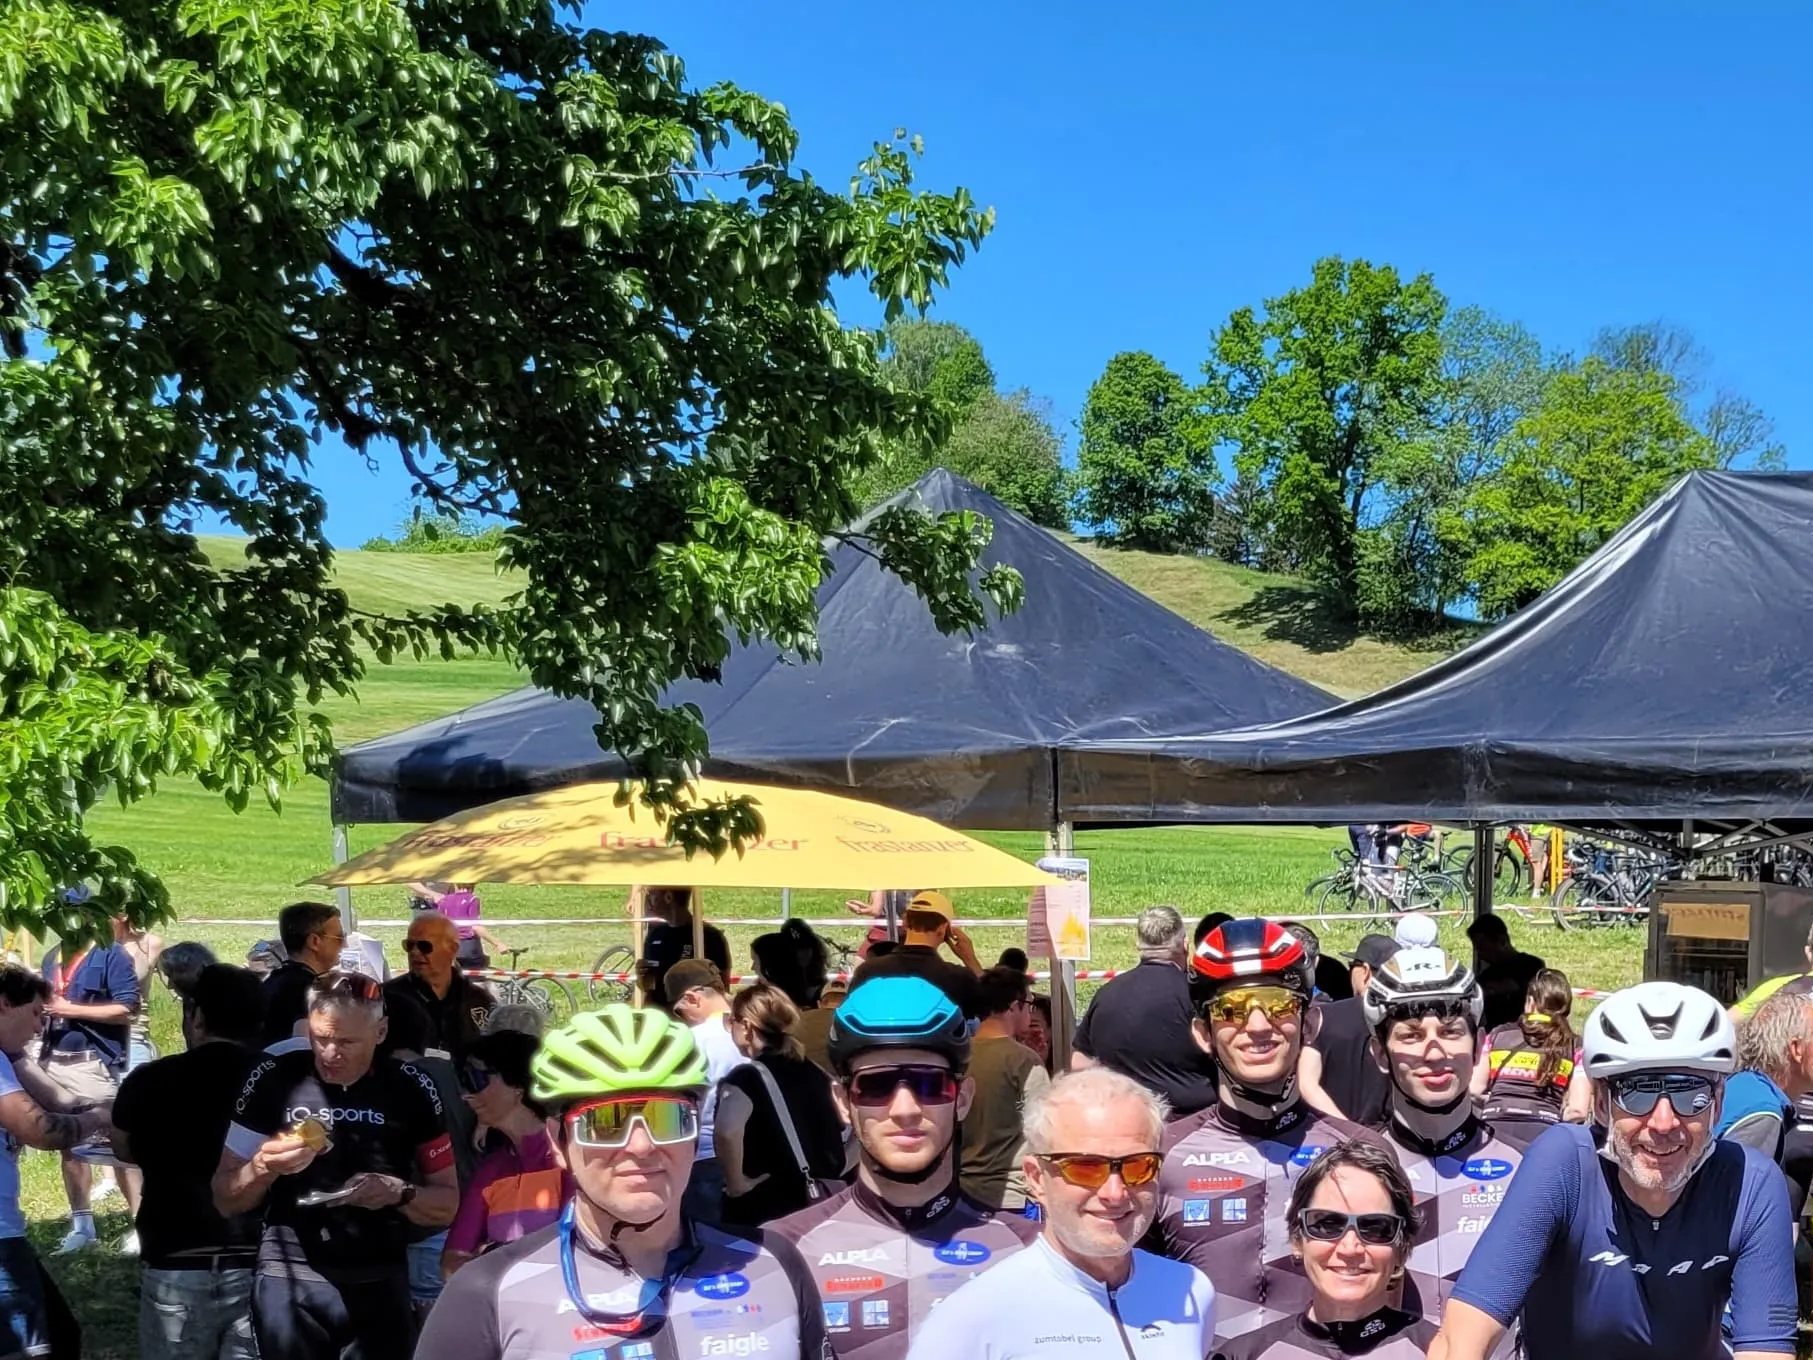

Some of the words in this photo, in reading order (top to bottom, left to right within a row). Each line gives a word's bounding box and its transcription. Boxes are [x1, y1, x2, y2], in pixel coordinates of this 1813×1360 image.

[836, 835, 975, 853] frastanzer
[1183, 1151, 1251, 1167] ALPLA
[818, 1248, 891, 1267] ALPLA
[700, 1332, 771, 1357] faigle
